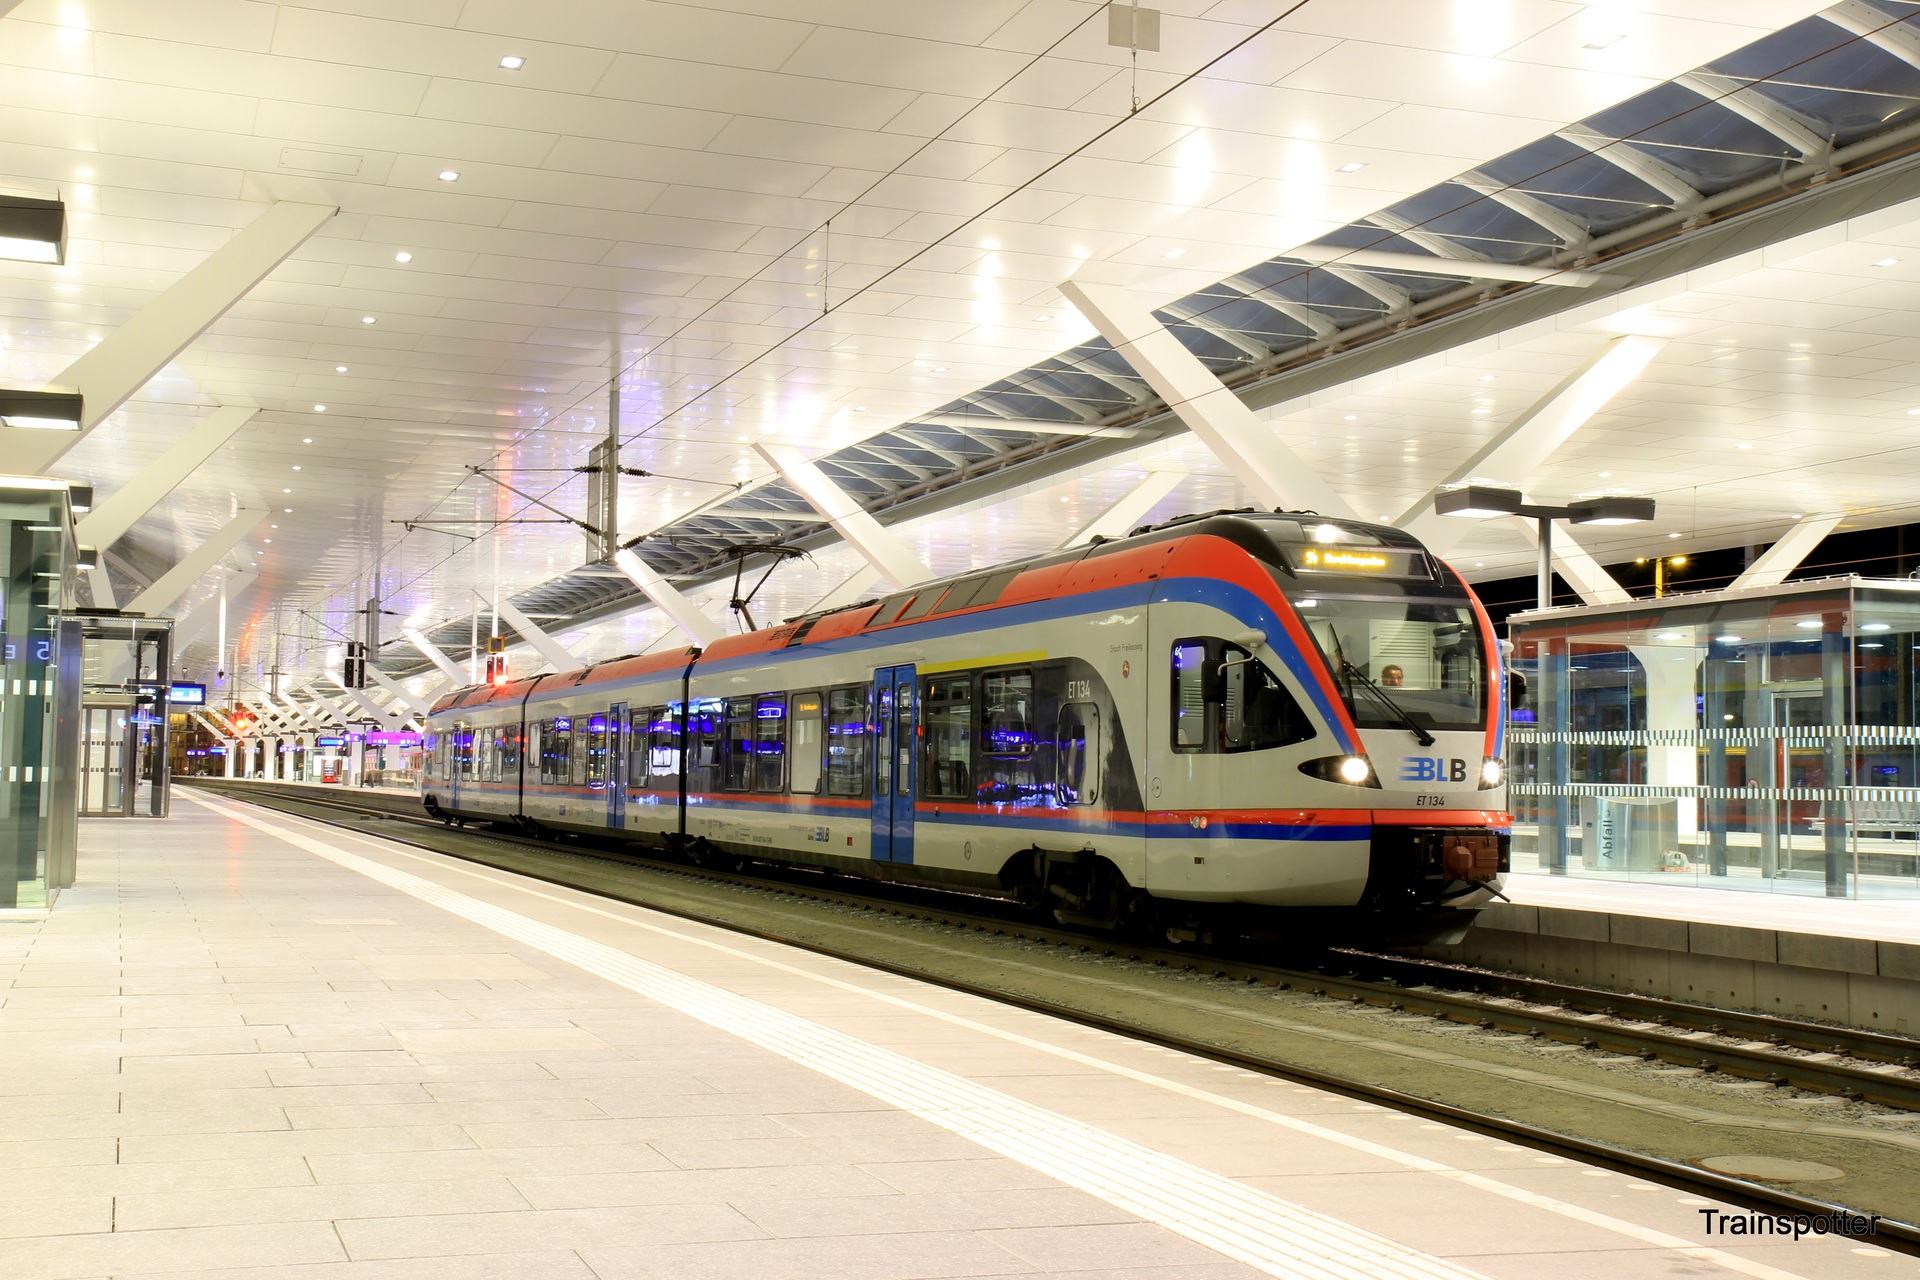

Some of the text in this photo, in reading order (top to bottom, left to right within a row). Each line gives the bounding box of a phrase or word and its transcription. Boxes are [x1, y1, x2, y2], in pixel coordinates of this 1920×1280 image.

[1068, 680, 1090, 699] ET 134
[1400, 757, 1467, 782] BLB
[1416, 795, 1445, 806] ET 134
[1603, 820, 1613, 859] Abfall
